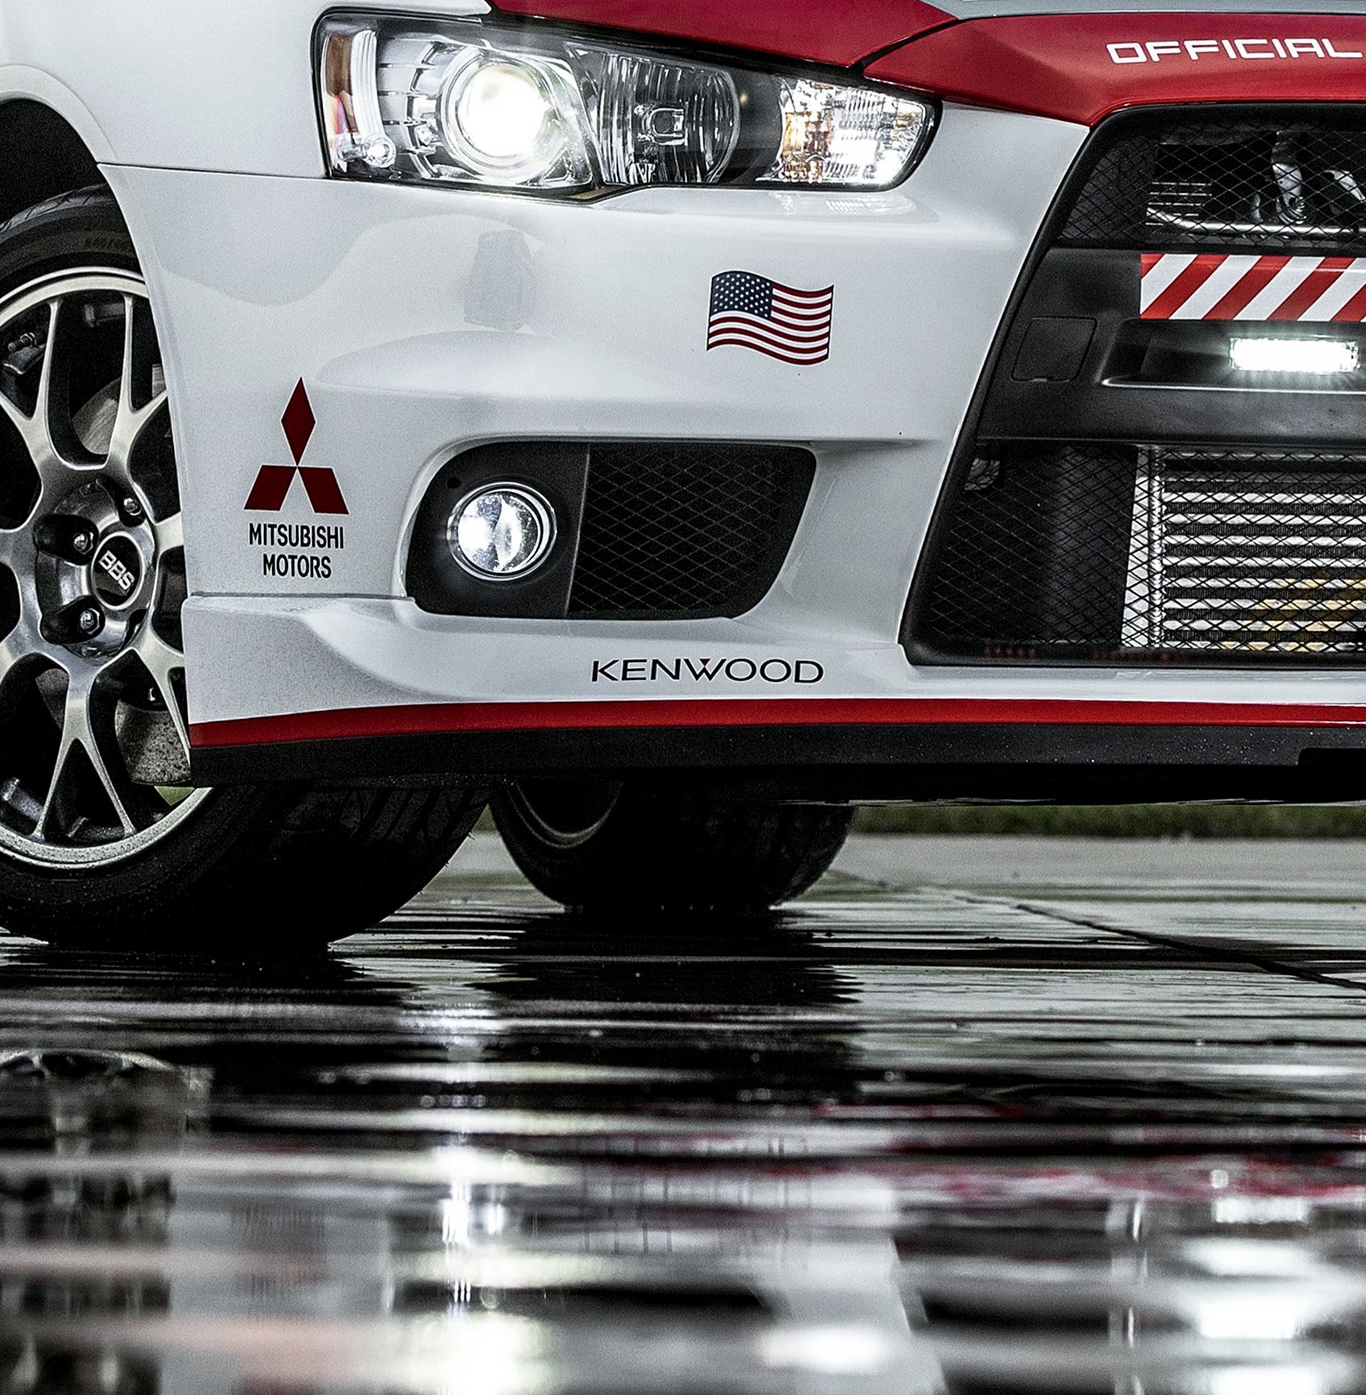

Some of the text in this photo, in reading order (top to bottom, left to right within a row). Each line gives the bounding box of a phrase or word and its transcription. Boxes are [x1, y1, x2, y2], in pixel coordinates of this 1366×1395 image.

[1106, 37, 1363, 65] OFFICIAL
[249, 522, 344, 549] MITSUBISHI
[98, 550, 135, 590] BBS
[262, 553, 332, 579] MOTORS
[591, 658, 824, 684] KENWOOD
